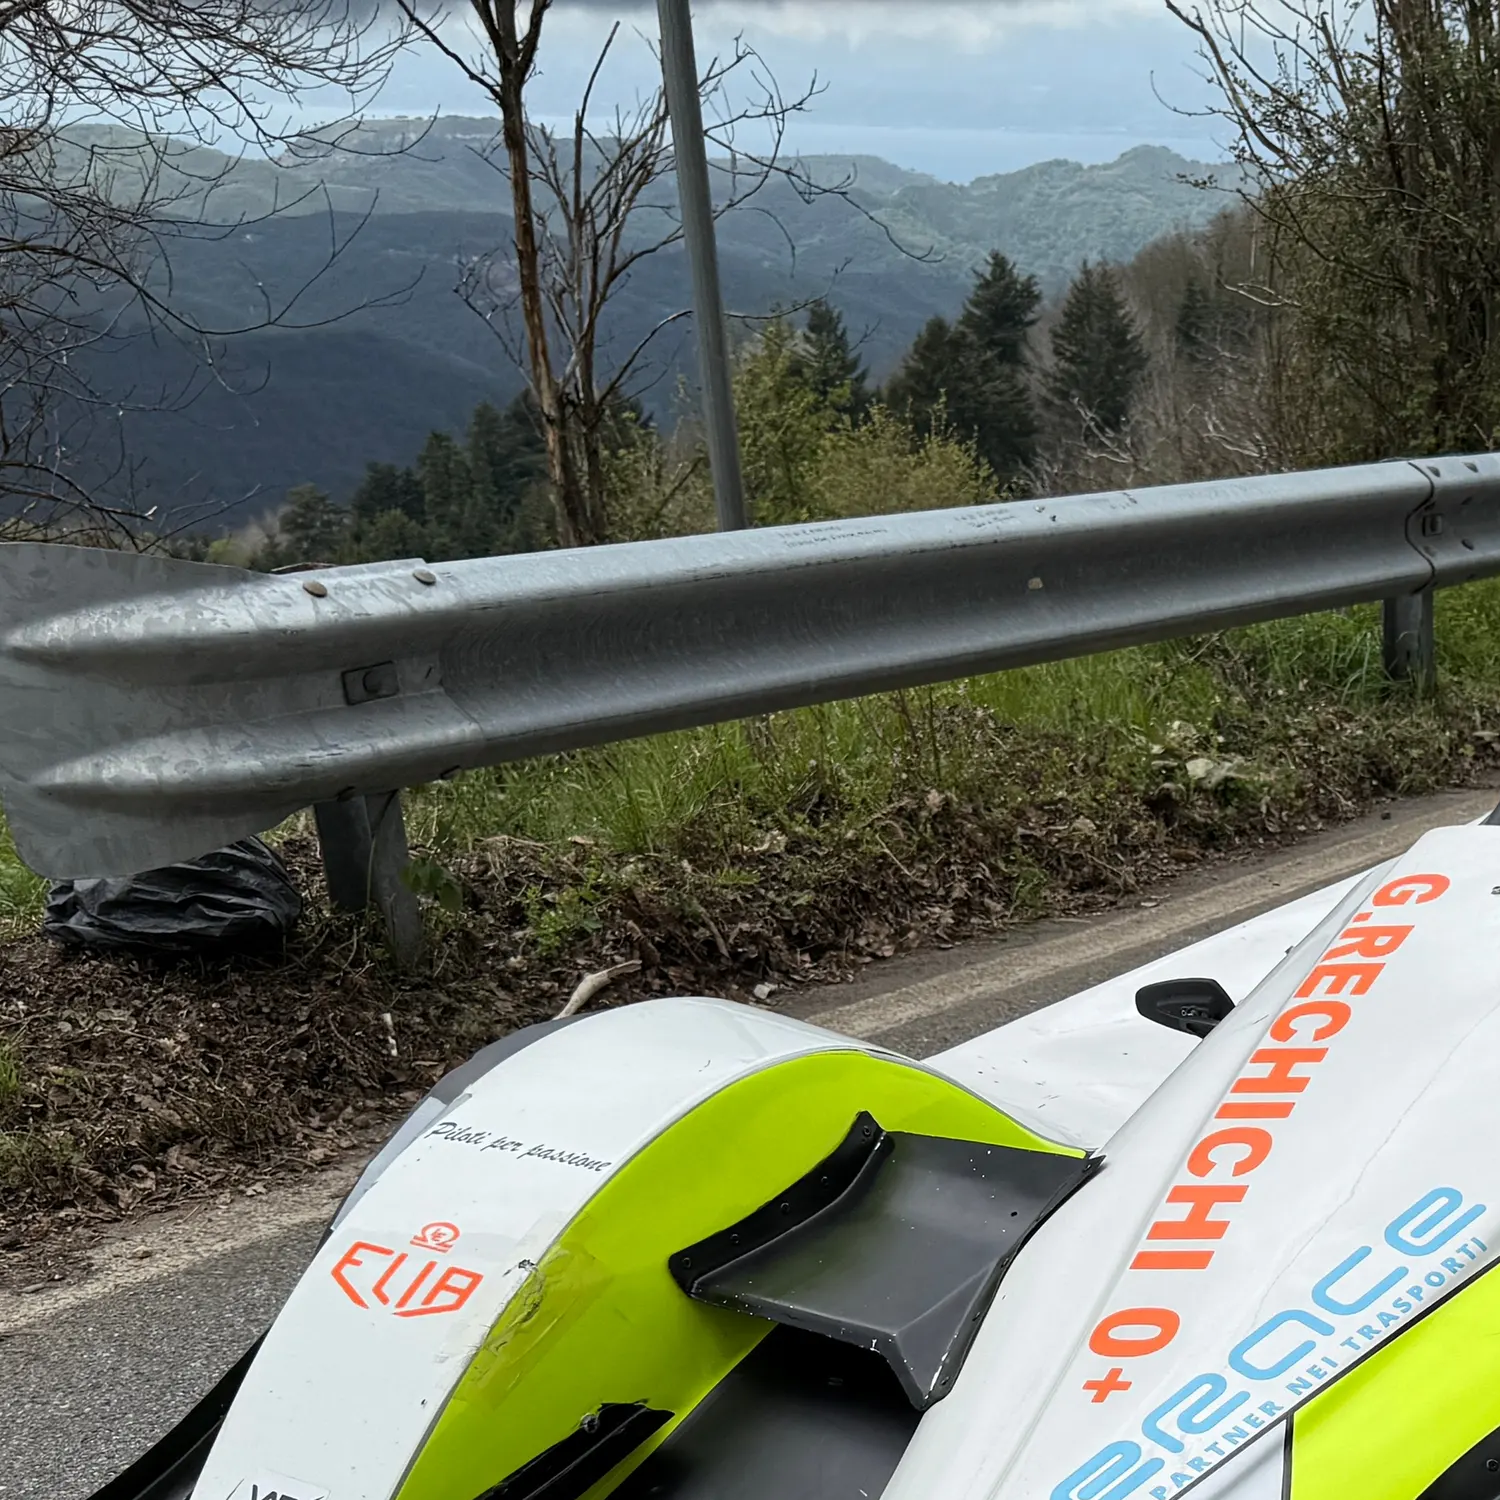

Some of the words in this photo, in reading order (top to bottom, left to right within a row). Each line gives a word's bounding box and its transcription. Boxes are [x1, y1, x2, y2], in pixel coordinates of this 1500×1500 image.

[1131, 874, 1450, 1270] G.RECHICHI
[424, 1121, 492, 1146] Piloti
[480, 1136, 524, 1152] per
[516, 1143, 612, 1172] passione
[331, 1241, 484, 1318] ELIA
[1285, 1356, 1342, 1397] NEI
[1340, 1236, 1489, 1355] TRASPORTI
